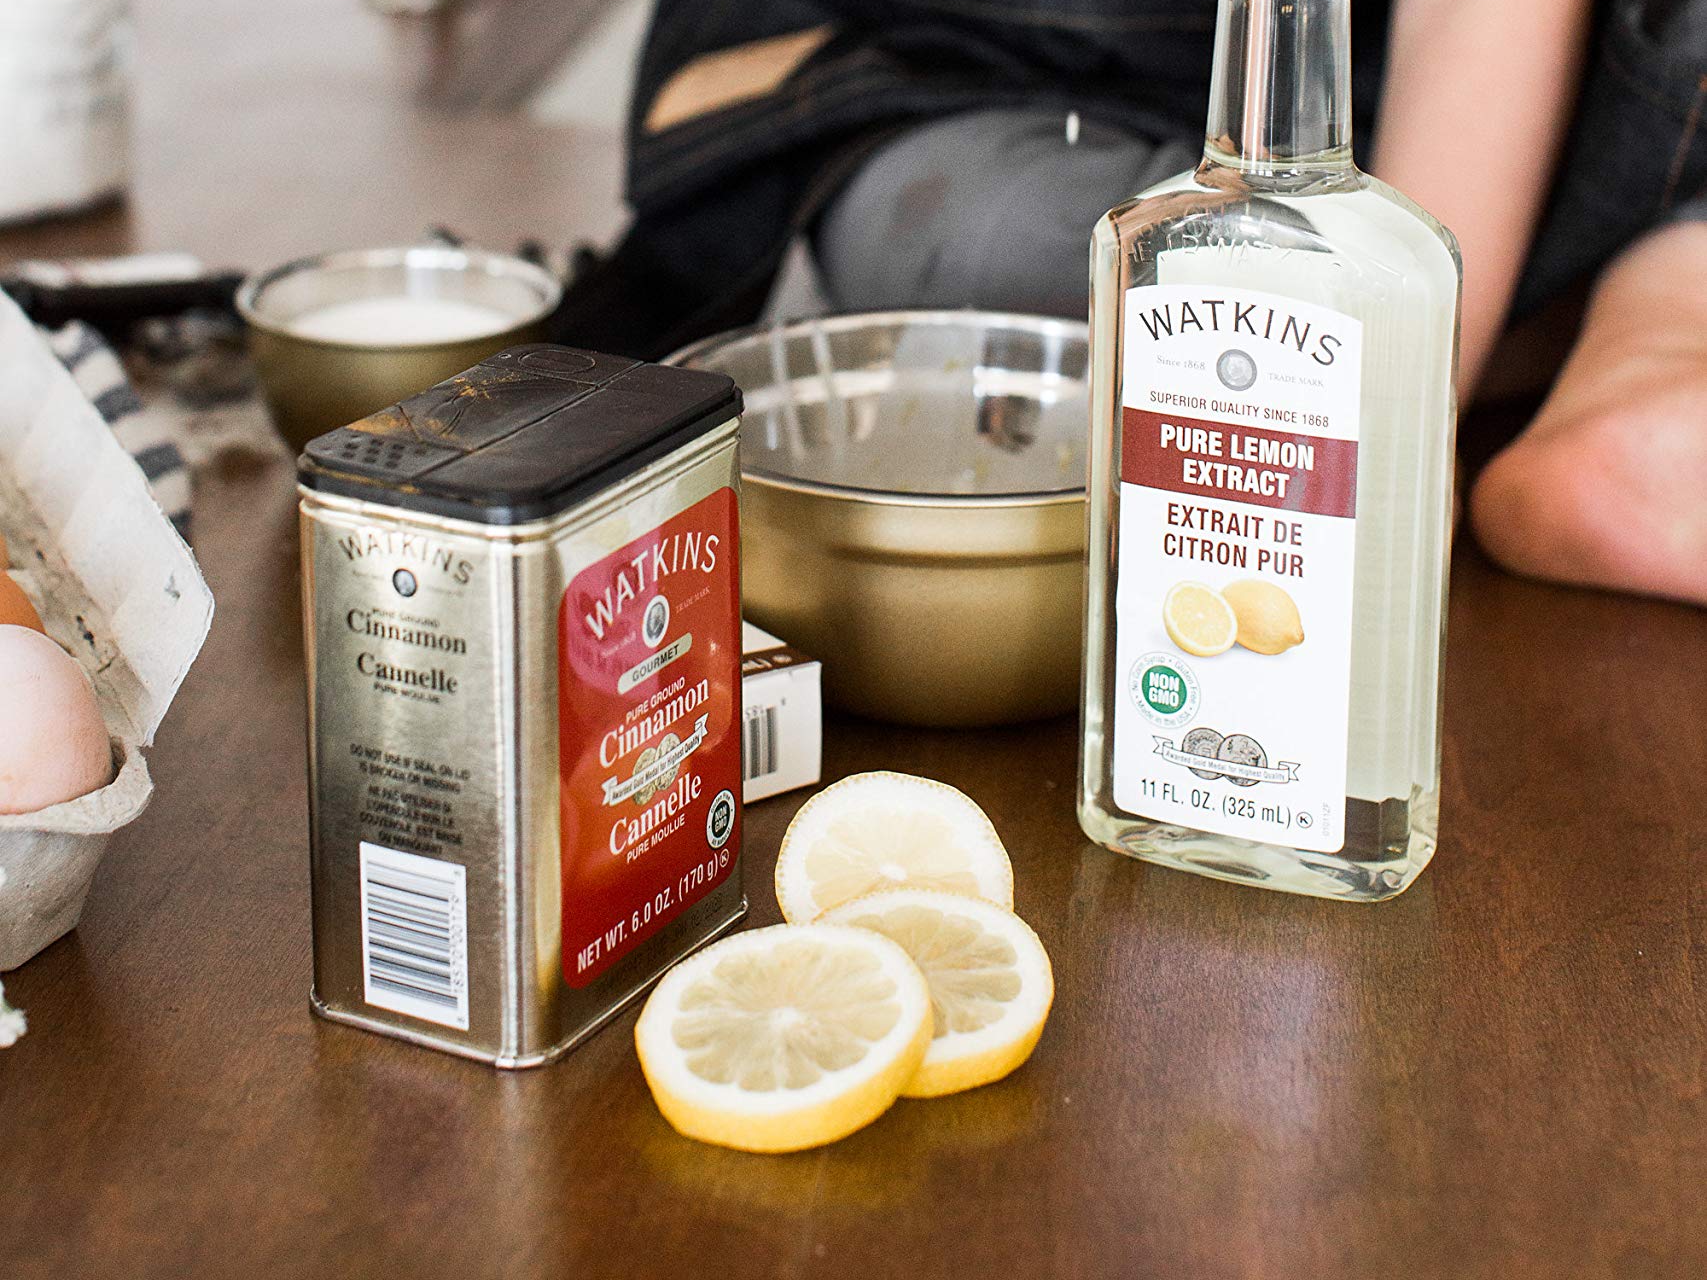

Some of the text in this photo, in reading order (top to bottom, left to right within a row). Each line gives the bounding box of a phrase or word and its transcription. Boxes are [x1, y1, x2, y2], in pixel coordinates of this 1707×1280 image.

[1139, 299, 1343, 366] WATKINS
[1157, 354, 1207, 371] Since 1868
[1267, 372, 1325, 388] TRADE MARK
[1150, 390, 1330, 428] SUPERIOR QUALITY SINCE 1868
[1160, 423, 1315, 471] PURE LEMON
[1182, 458, 1291, 499] EXTRACT
[1167, 502, 1304, 546] EXTRAIT DE
[337, 531, 475, 586] WATKINS
[1163, 532, 1304, 578] CITRON PUR
[585, 531, 720, 641] WATKINS
[347, 608, 468, 655] Cinnamon
[356, 651, 459, 693] Cannelle
[631, 643, 680, 683] GOURMET
[1148, 671, 1181, 693] NON
[625, 676, 686, 725] PURE GROUND
[1148, 686, 1180, 708] GMO
[599, 677, 710, 769] Cinnamon
[1165, 749, 1191, 763] Awarded
[609, 771, 703, 856] Cannelle
[714, 803, 728, 822] NON
[1141, 778, 1156, 799] 11
[1162, 783, 1184, 805] FL.
[1191, 789, 1216, 812] OZ.
[1222, 794, 1256, 819] (325
[1261, 804, 1292, 830] mL)
[626, 812, 686, 865] PURE MOULUE
[577, 936, 603, 974] NET
[605, 919, 629, 953] WT.
[631, 900, 652, 933] 6.0
[654, 886, 675, 917] OZ.
[678, 862, 704, 903] (170
[707, 852, 719, 881] g)
